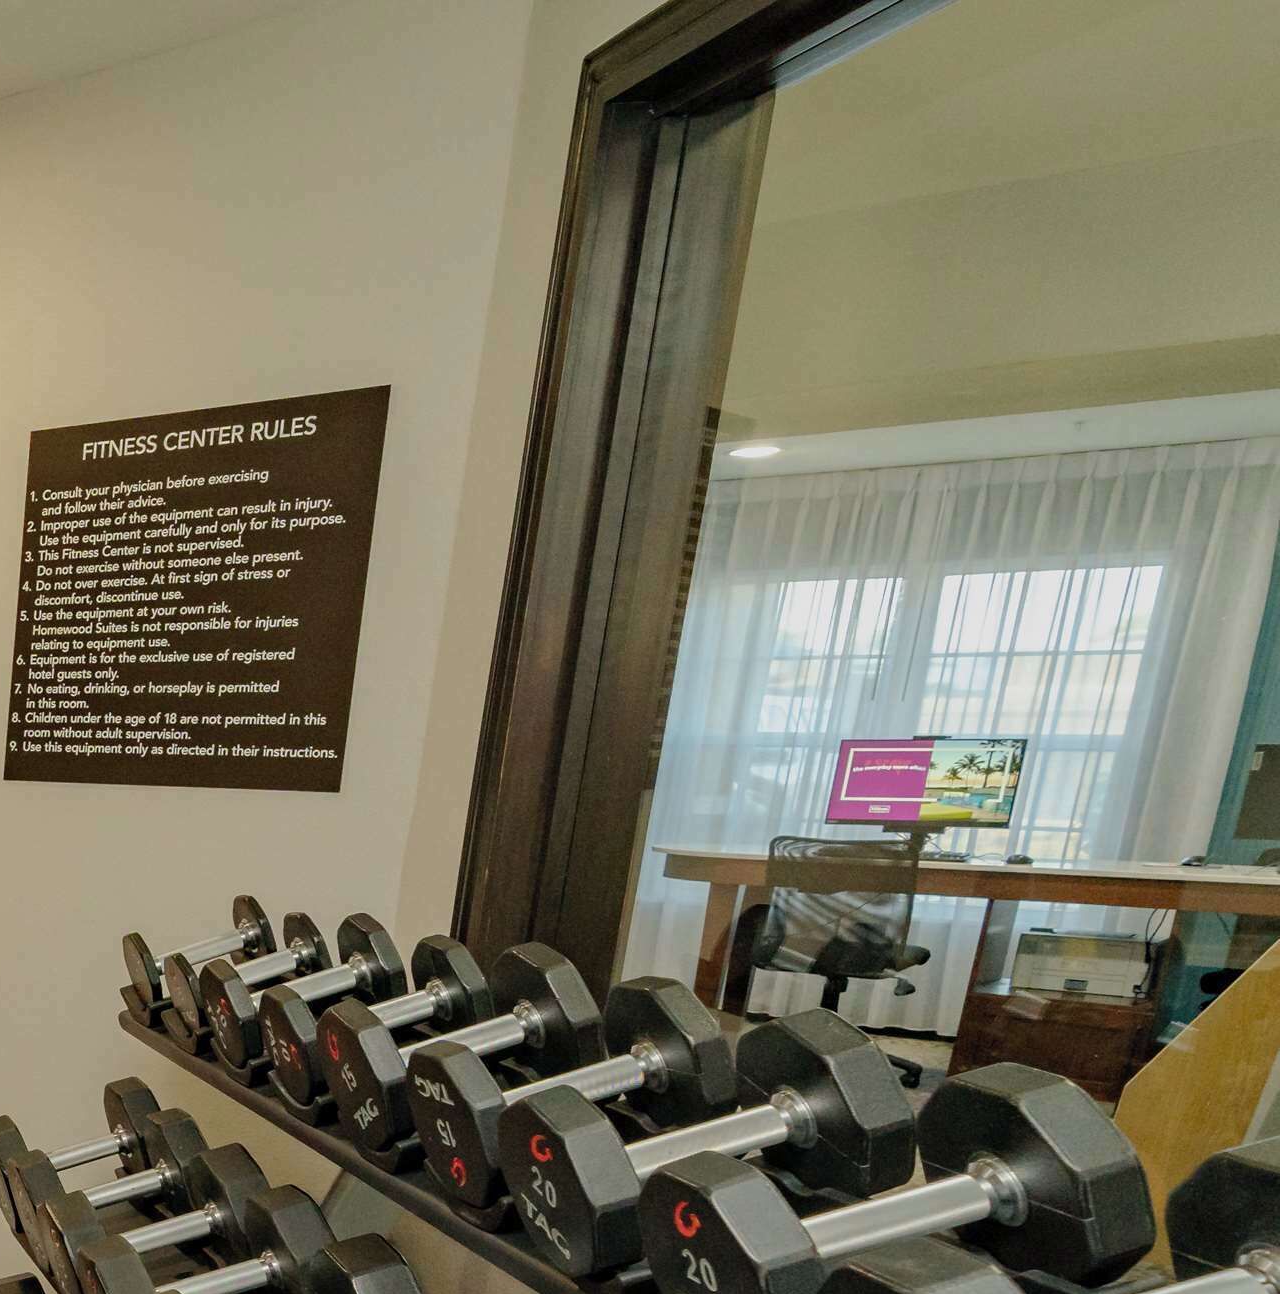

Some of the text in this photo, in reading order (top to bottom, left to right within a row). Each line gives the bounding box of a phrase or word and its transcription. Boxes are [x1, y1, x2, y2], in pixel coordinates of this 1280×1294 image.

[82, 415, 317, 460] FITNESS CENTER RULES
[29, 468, 268, 502] 1. Consult your physician before exercising
[26, 496, 332, 534] 2. Improper use of the equipment can result in injury.
[41, 494, 166, 516] and follow their advice.
[39, 514, 345, 546] Use the equipment carefully and only for its purpose.
[24, 534, 244, 562] 3. This Fitness Center is not supervised.
[36, 549, 303, 576] Do not exercise without someone else present.
[21, 567, 291, 591] 4. Do not over exercise. At first sign of stress or
[33, 589, 184, 606] discomfort, discontinue use.
[19, 600, 231, 622] 5. Use the equipment at your own risk.
[32, 615, 298, 635] Homewood Suites is not responsible for injuries
[30, 636, 170, 652] relating to equipment use.
[15, 647, 295, 668] 6. Equipment is for the exclusive use of registered
[28, 666, 119, 682] hotel guests only.
[14, 679, 279, 696] 7. No eating, drinking, or horseplay is permitted
[25, 696, 89, 708] in this room.
[11, 711, 326, 728] 8. Children under the age of 18 are not permitted in this
[23, 726, 191, 742] room without adult supervision.
[9, 740, 337, 758] 9. Use this equipment only as directed in their instructions.
[341, 1063, 357, 1092] 15
[414, 1074, 455, 1106] TAG
[353, 1097, 380, 1130] TAG
[436, 1118, 456, 1148] 15
[531, 1165, 557, 1208] 20
[521, 1192, 571, 1260] TAG
[682, 1249, 718, 1292] 20
